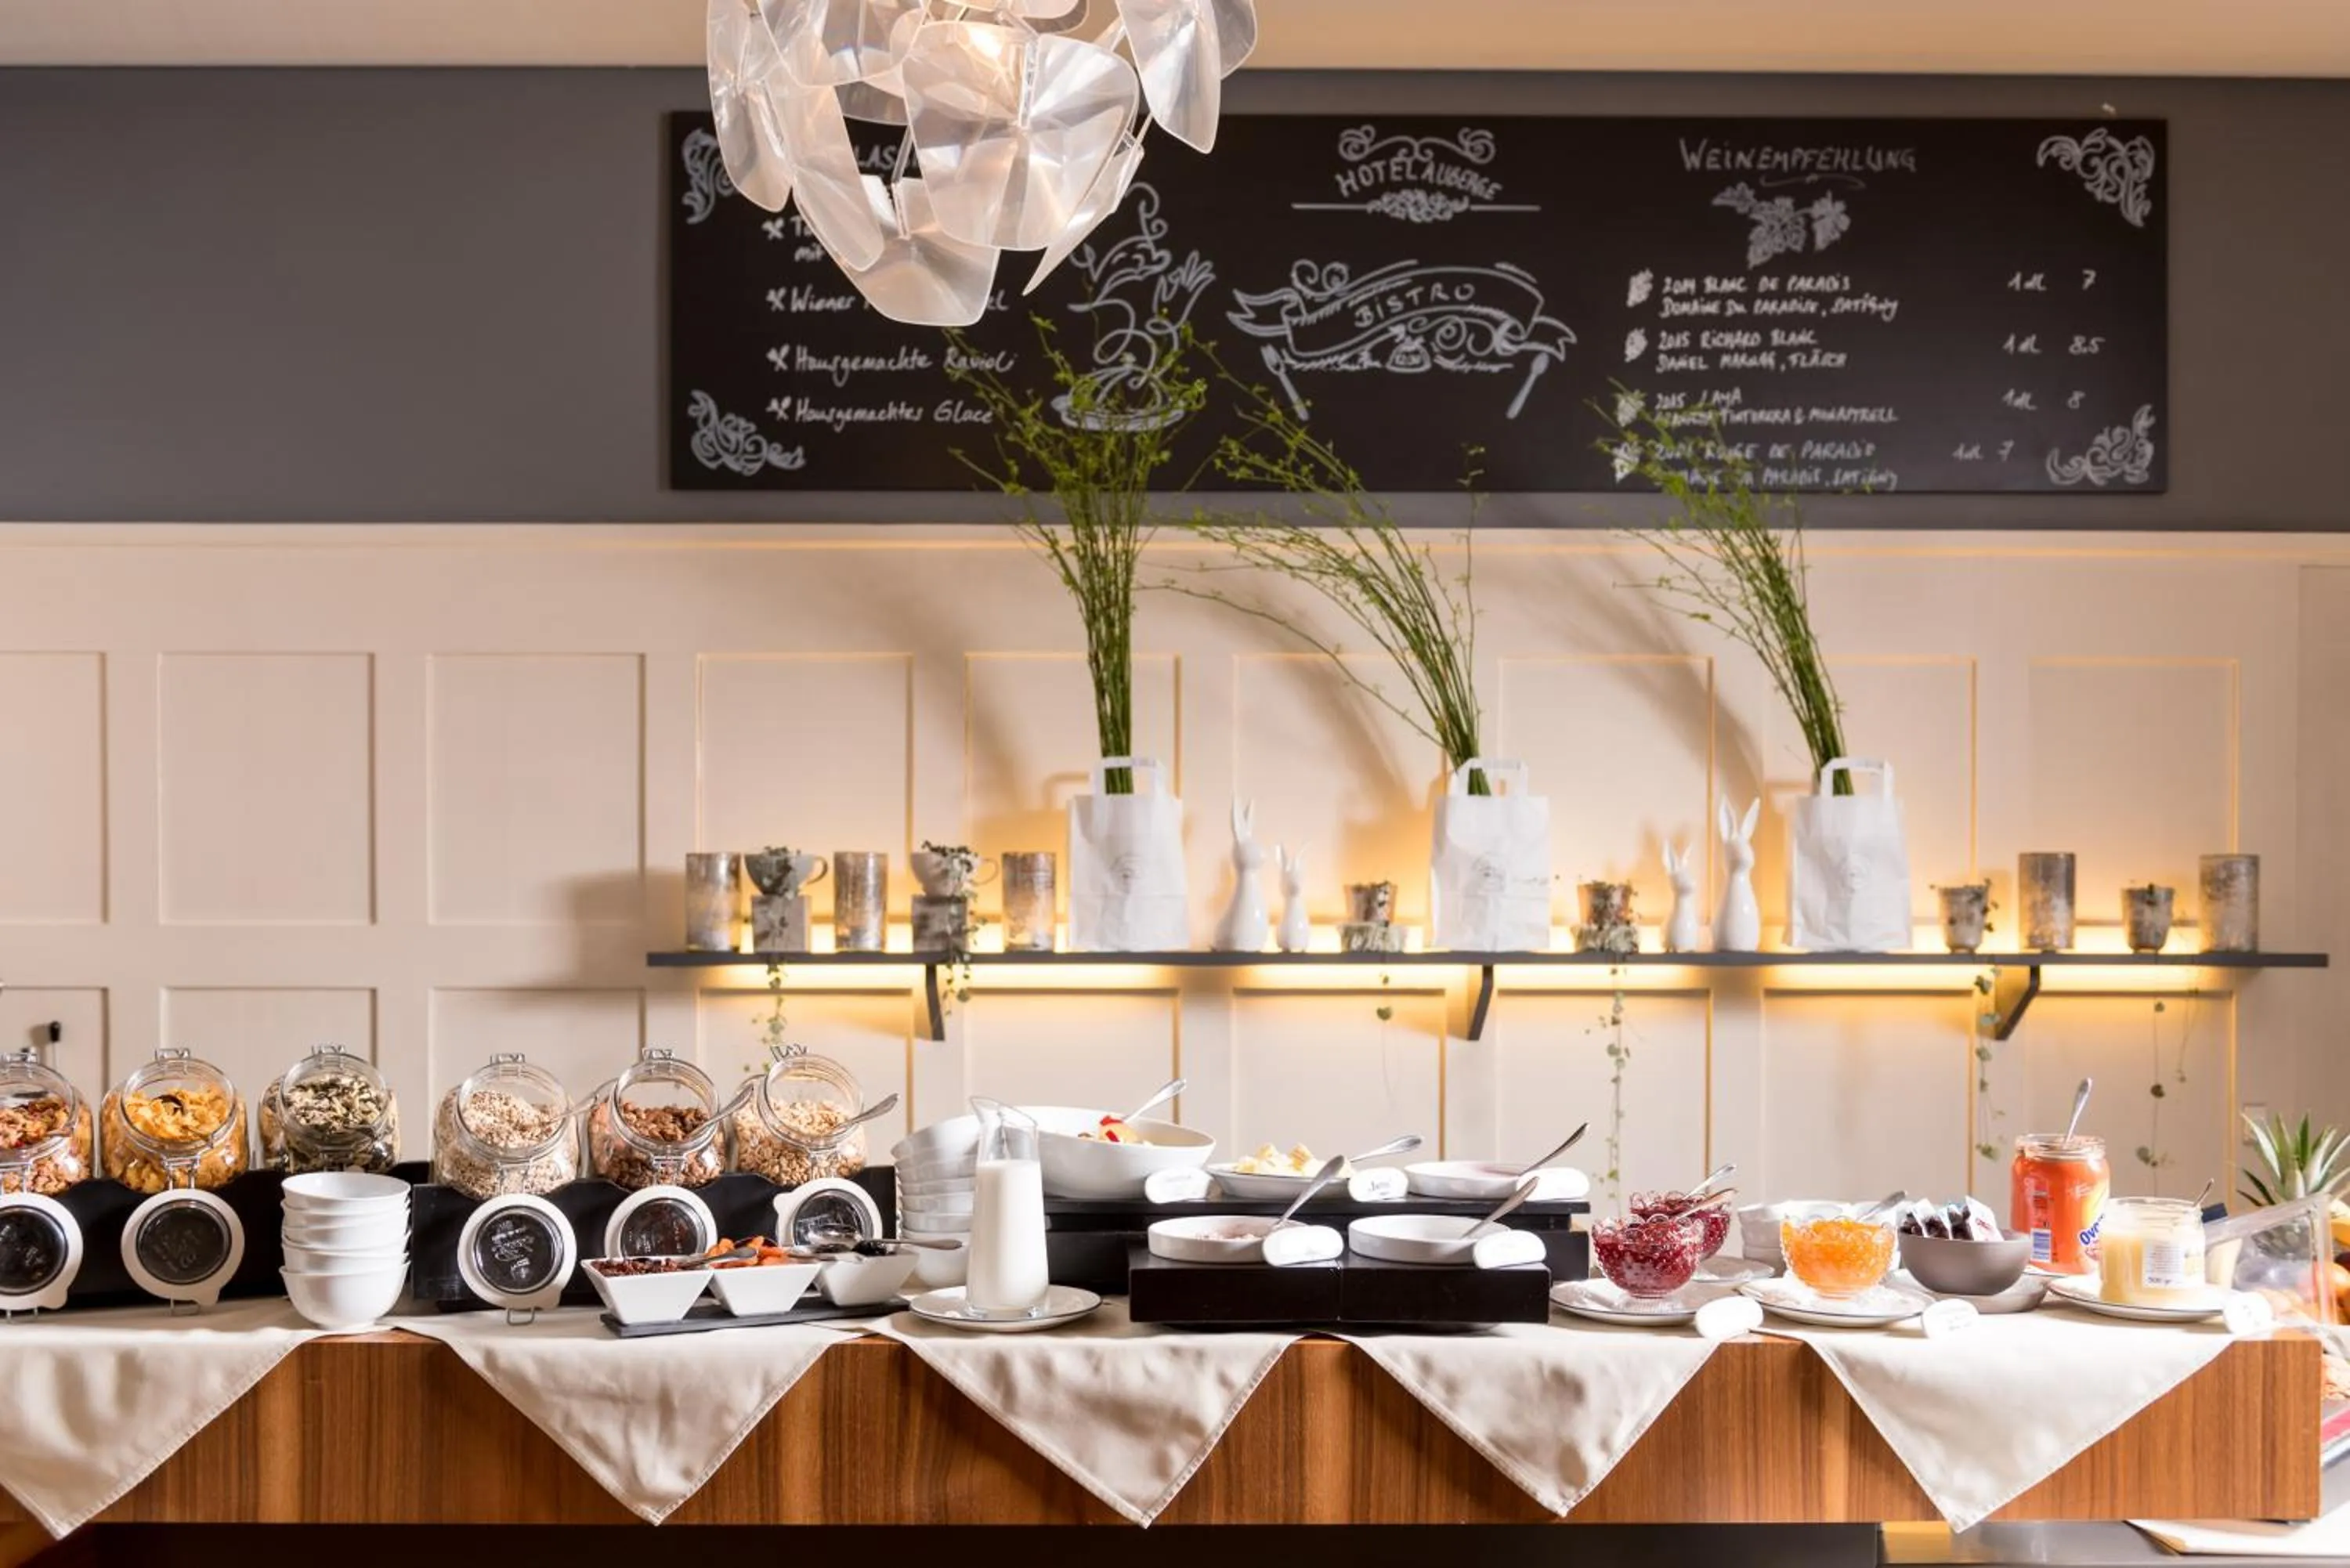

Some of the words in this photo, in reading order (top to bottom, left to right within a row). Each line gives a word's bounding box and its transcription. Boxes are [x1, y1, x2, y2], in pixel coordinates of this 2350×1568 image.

[1335, 157, 1418, 197] HOTEL
[1758, 276, 1780, 293] DE
[2082, 269, 2096, 290] 7
[790, 284, 855, 313] Wiener
[1658, 329, 1690, 350] 2015
[1770, 327, 1818, 347] BLANC
[795, 345, 933, 387] Hausgemachte
[943, 345, 1018, 372] Ravioli
[795, 397, 924, 432] Hausgemachtes
[934, 399, 993, 424] Glace
